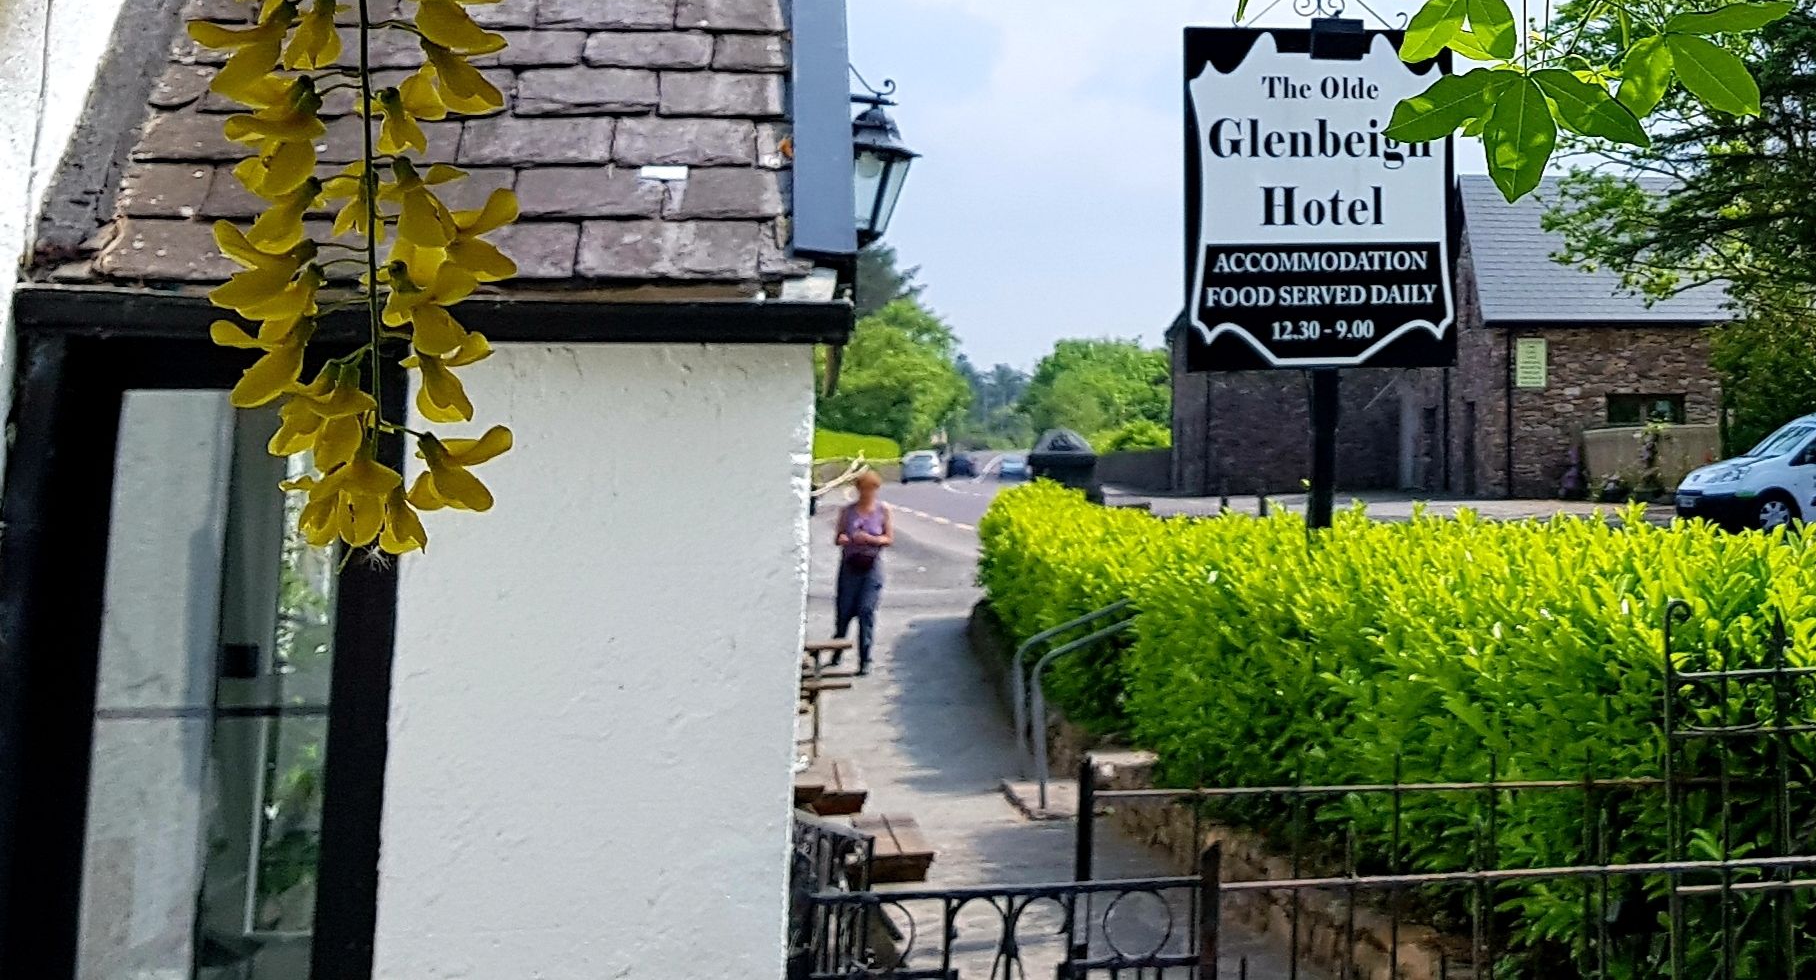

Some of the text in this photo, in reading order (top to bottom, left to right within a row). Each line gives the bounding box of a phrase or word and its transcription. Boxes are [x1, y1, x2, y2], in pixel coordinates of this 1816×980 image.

[1261, 76, 1379, 100] The Olde
[1259, 185, 1384, 226] Hotel
[1212, 250, 1428, 273] ACCOMMODATION
[1205, 283, 1437, 307] FOOD SERVED DAILY
[1271, 320, 1321, 340] 12.30
[1335, 319, 1375, 339] 9.00
